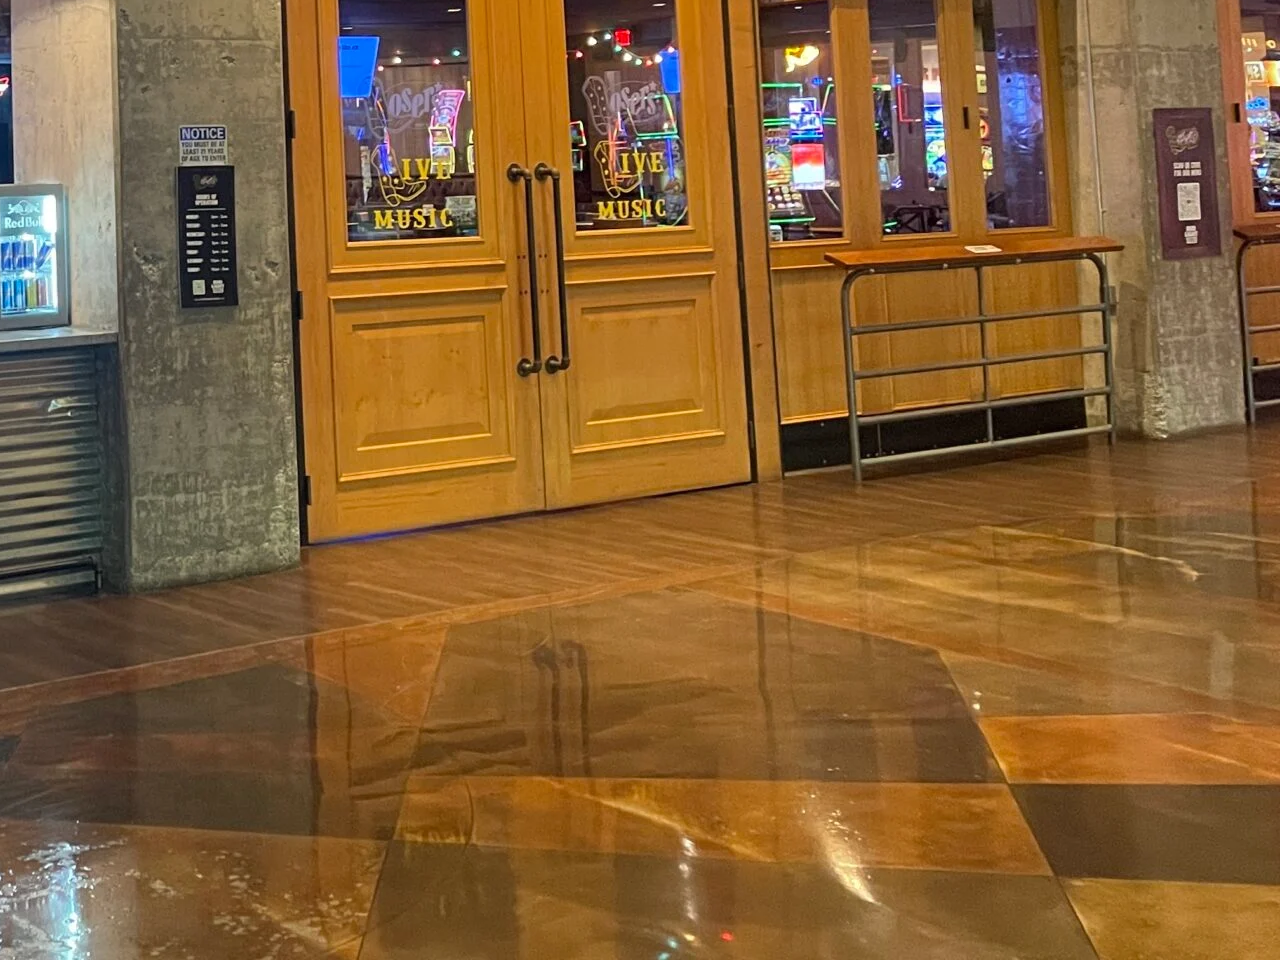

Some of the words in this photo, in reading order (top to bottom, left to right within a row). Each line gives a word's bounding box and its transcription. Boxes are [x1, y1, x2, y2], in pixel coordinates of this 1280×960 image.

[181, 128, 225, 140] NOTICE
[596, 198, 667, 221] MUSIC
[4, 216, 25, 229] Red
[373, 207, 454, 231] MUSIC
